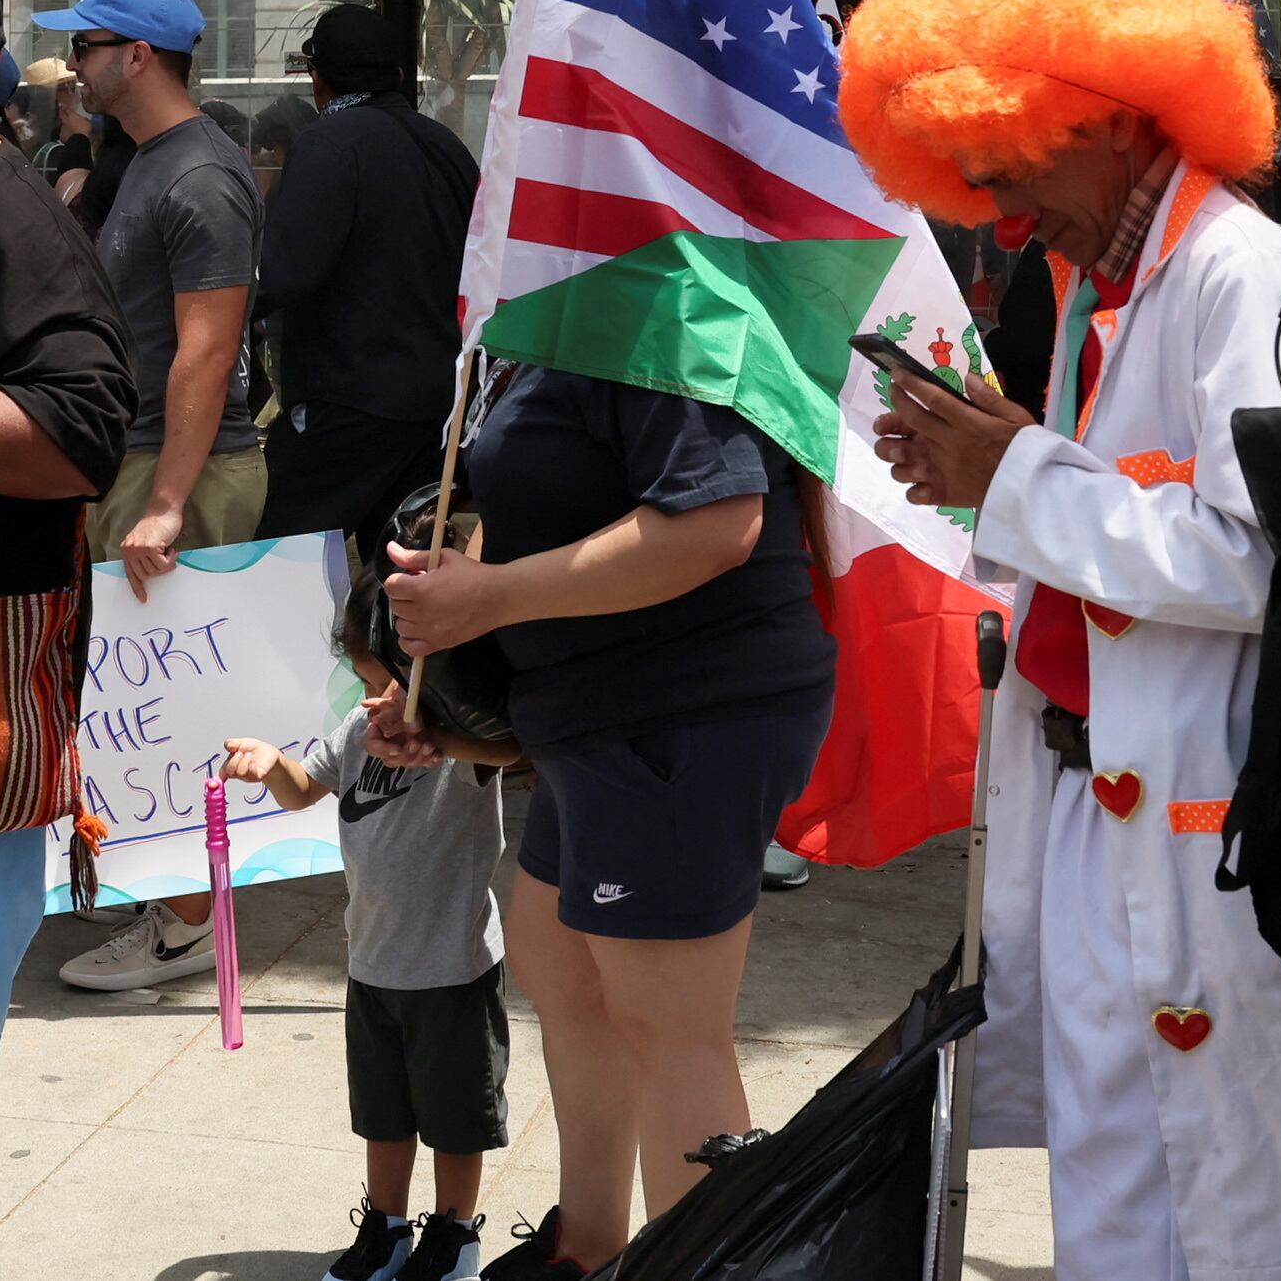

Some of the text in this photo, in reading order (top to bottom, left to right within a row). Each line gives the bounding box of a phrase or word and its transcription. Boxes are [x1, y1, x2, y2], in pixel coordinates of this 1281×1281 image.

[85, 618, 229, 693] PORT
[79, 697, 172, 752] THE
[598, 882, 624, 897] NIKE
